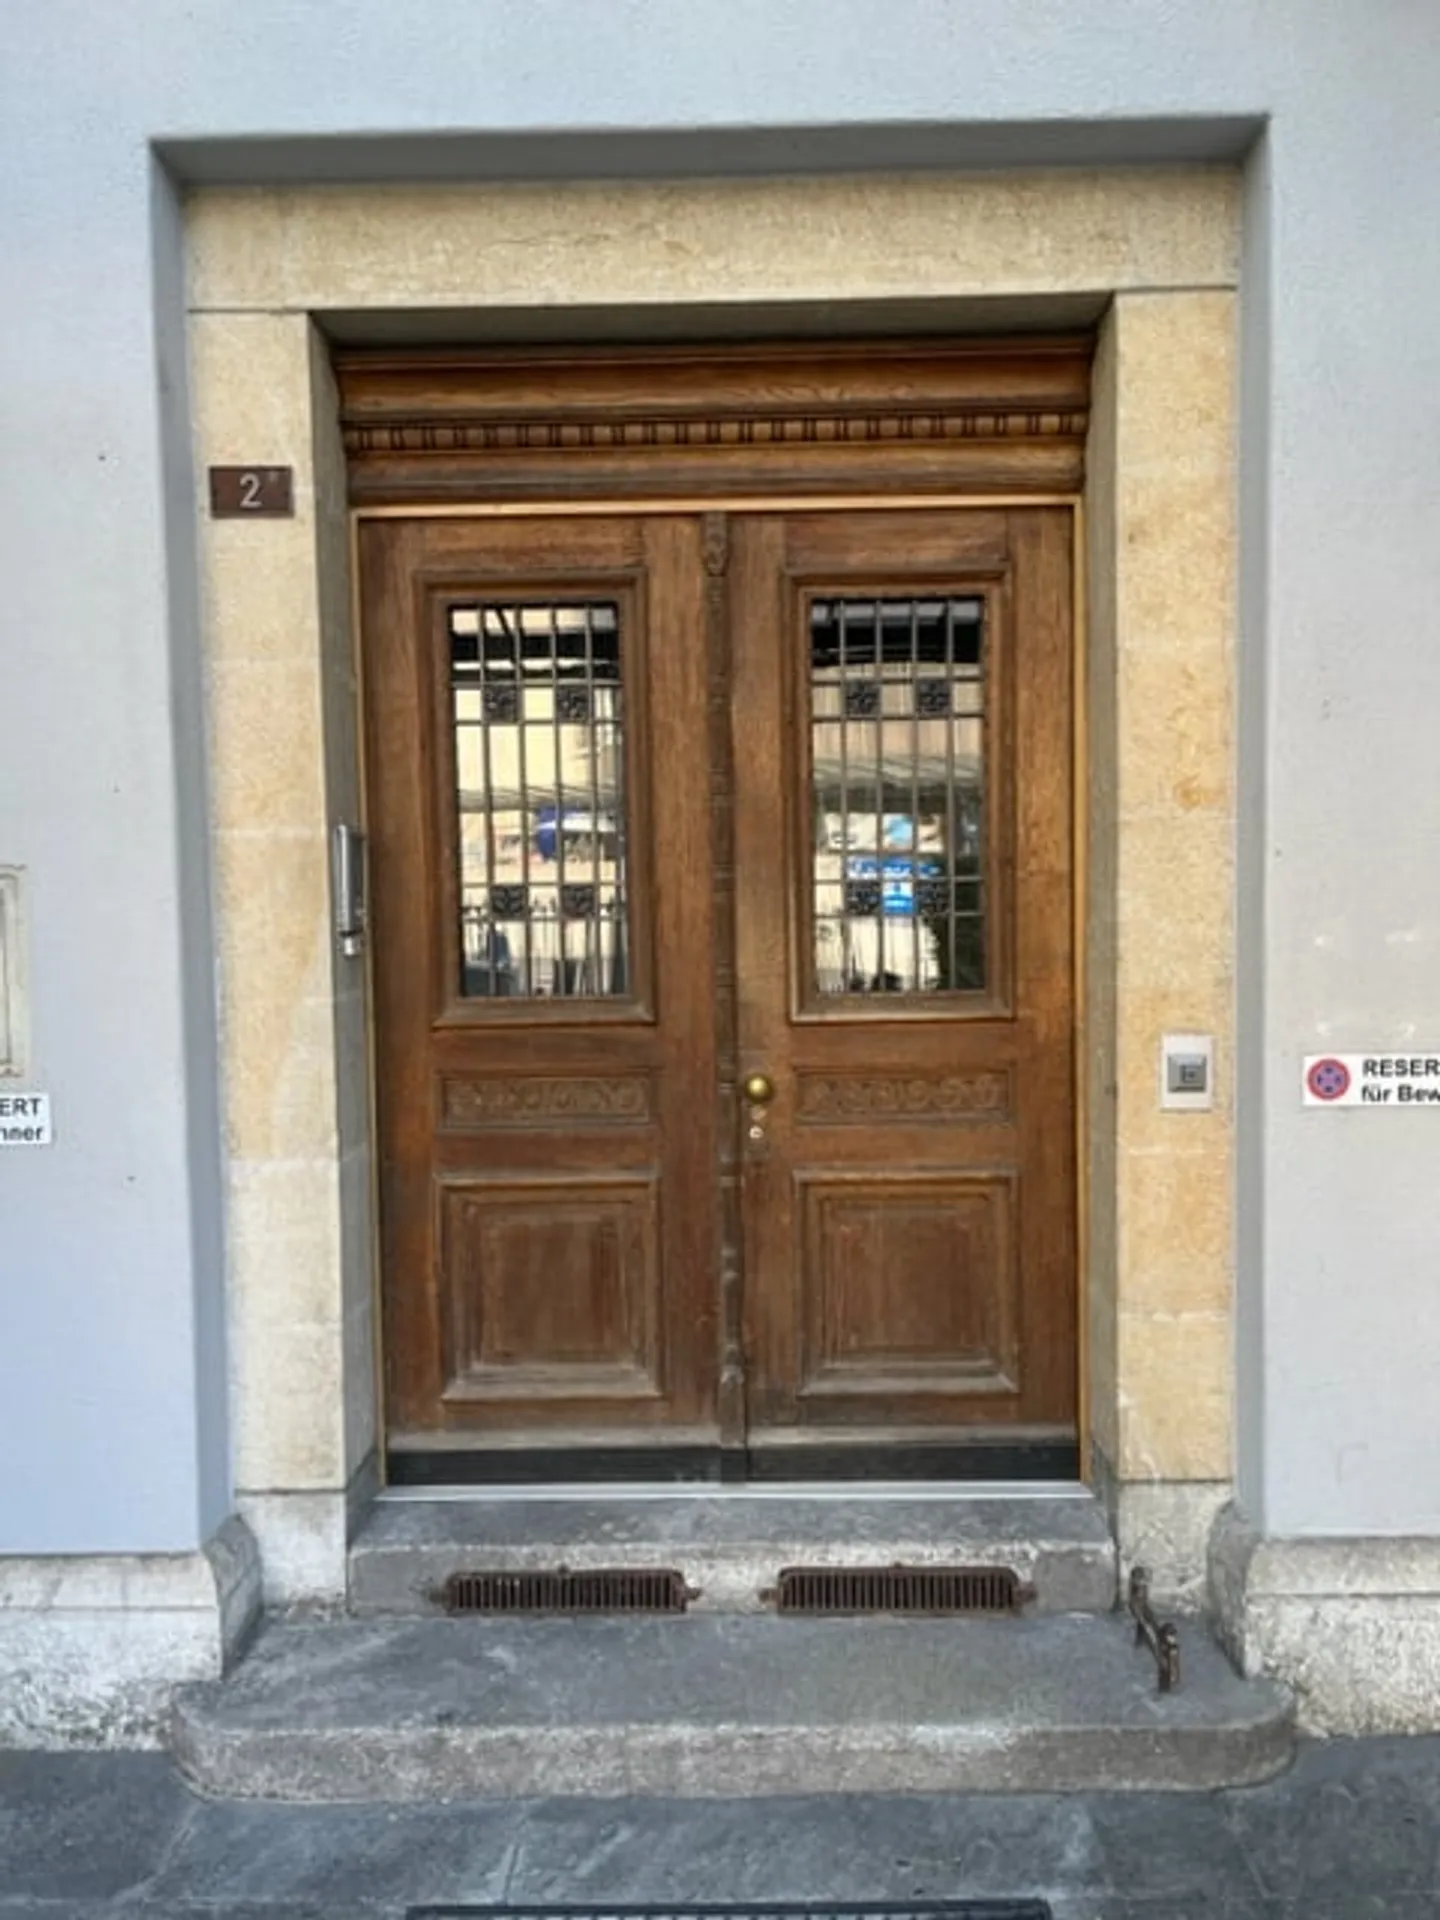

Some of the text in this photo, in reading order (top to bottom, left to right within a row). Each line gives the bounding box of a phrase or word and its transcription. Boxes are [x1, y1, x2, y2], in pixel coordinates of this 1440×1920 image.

[240, 472, 262, 507] 2
[1362, 1058, 1440, 1077] RESER
[0, 1098, 42, 1115] ERT
